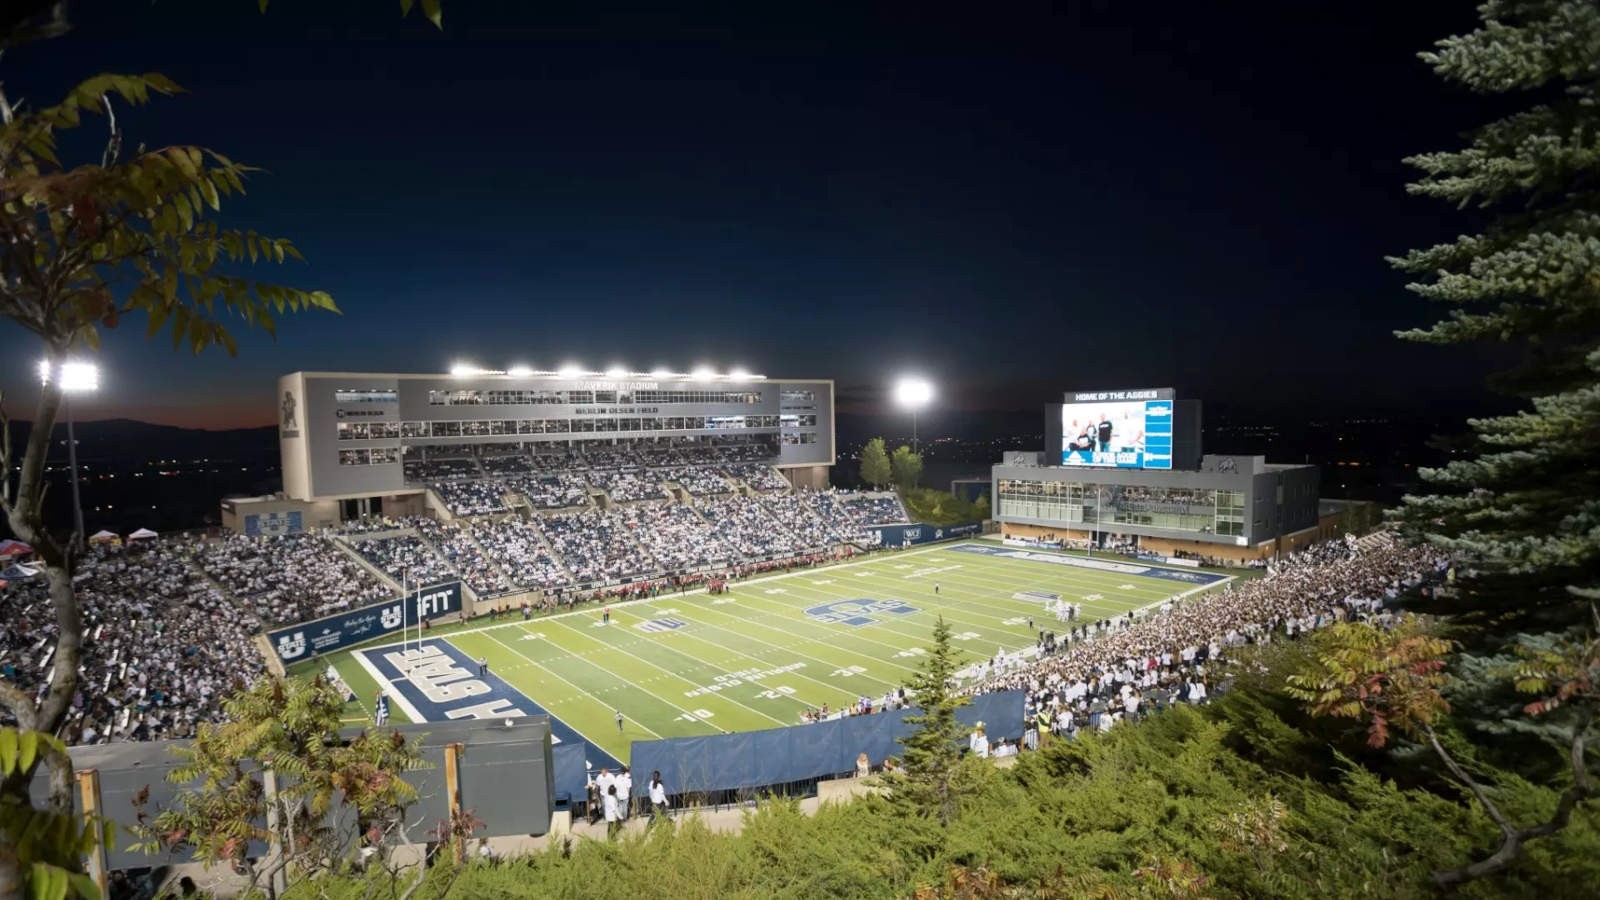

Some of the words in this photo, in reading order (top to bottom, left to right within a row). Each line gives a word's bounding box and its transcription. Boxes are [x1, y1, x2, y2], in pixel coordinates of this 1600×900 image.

[619, 382, 658, 390] STADIUM
[1075, 393, 1097, 401] HOME
[1098, 392, 1109, 400] OF
[1110, 391, 1125, 400] THE
[1126, 390, 1157, 399] AGGIES
[383, 645, 492, 703] STATE
[834, 665, 868, 677] 30
[758, 686, 798, 700] 20
[679, 708, 715, 722] 10
